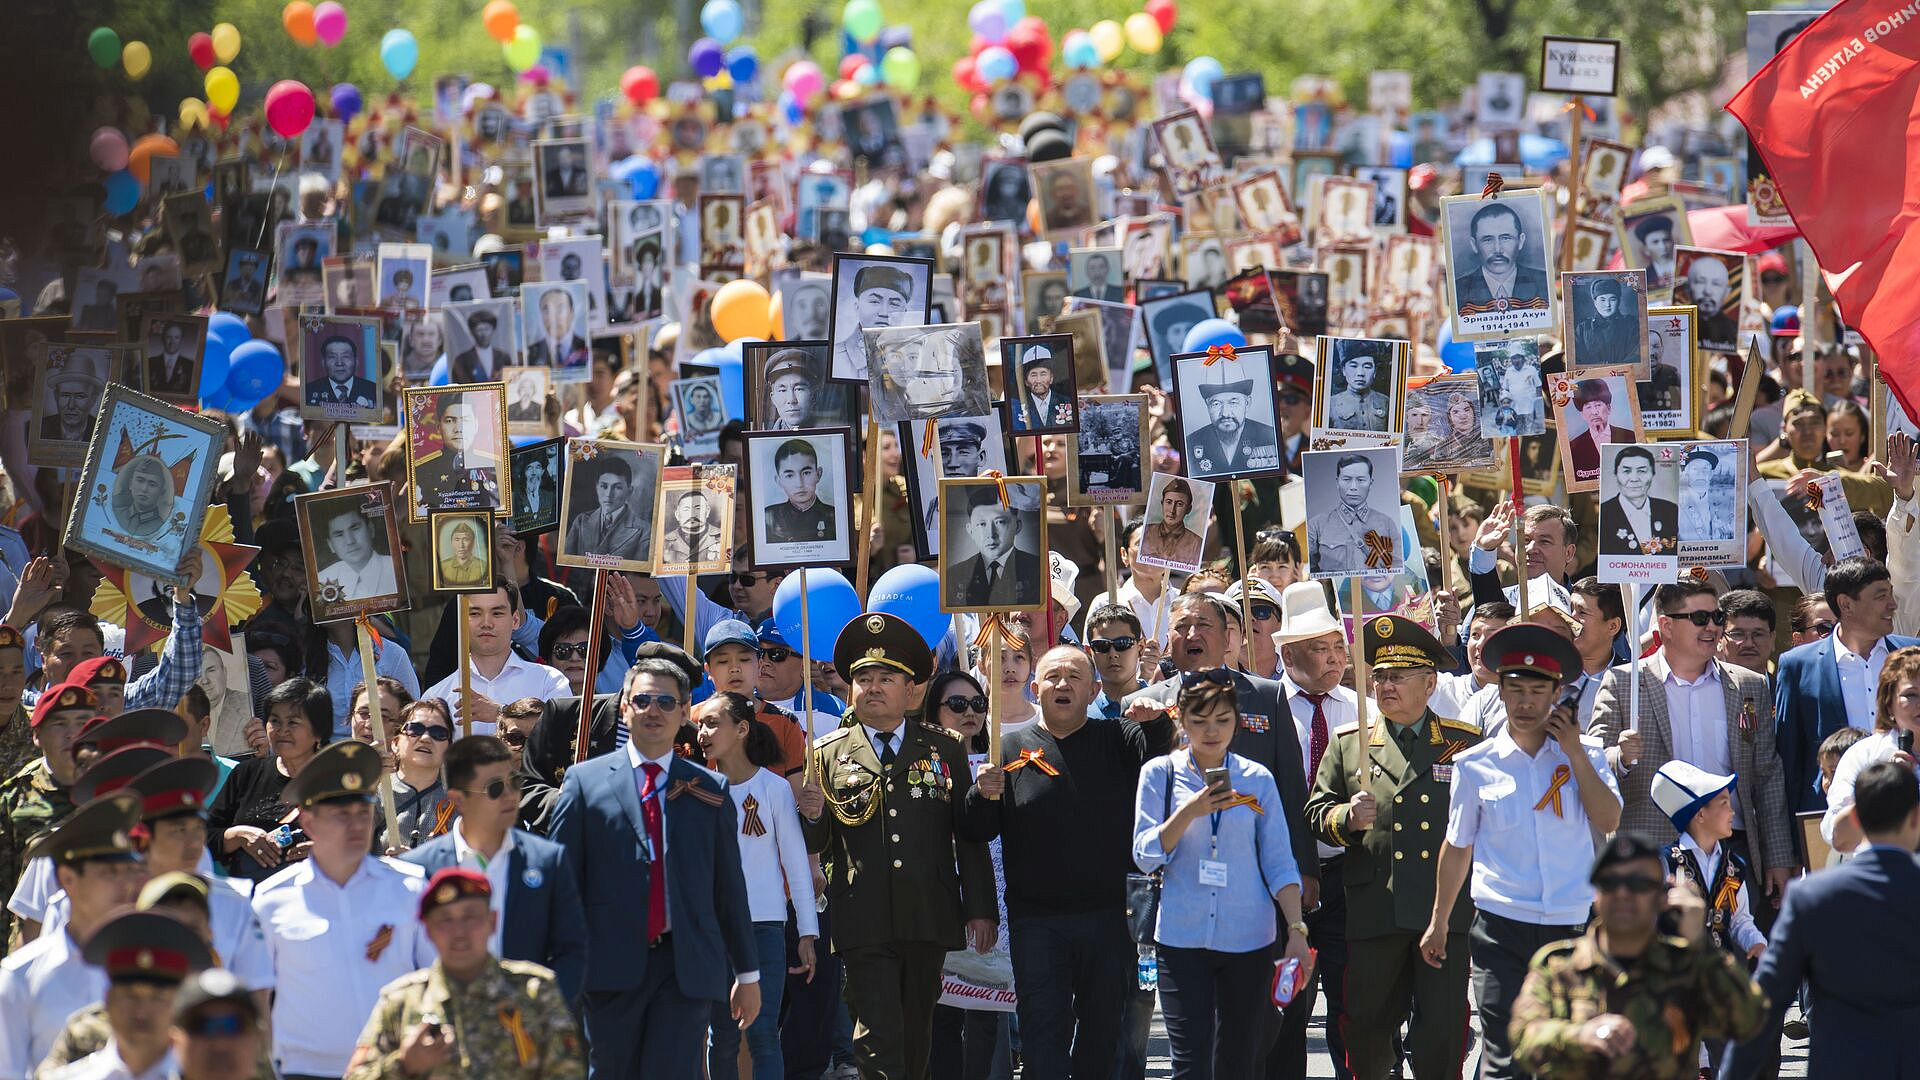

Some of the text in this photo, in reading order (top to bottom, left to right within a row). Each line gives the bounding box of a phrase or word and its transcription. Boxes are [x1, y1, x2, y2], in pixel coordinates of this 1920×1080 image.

[1463, 311, 1546, 325] Эрназаров Акун
[1481, 321, 1530, 331] 1914-1941
[1658, 412, 1682, 420] Кубан
[1678, 553, 1731, 562] лтанмамыт
[1628, 570, 1650, 578] АКУН
[942, 981, 993, 1001] нашей
